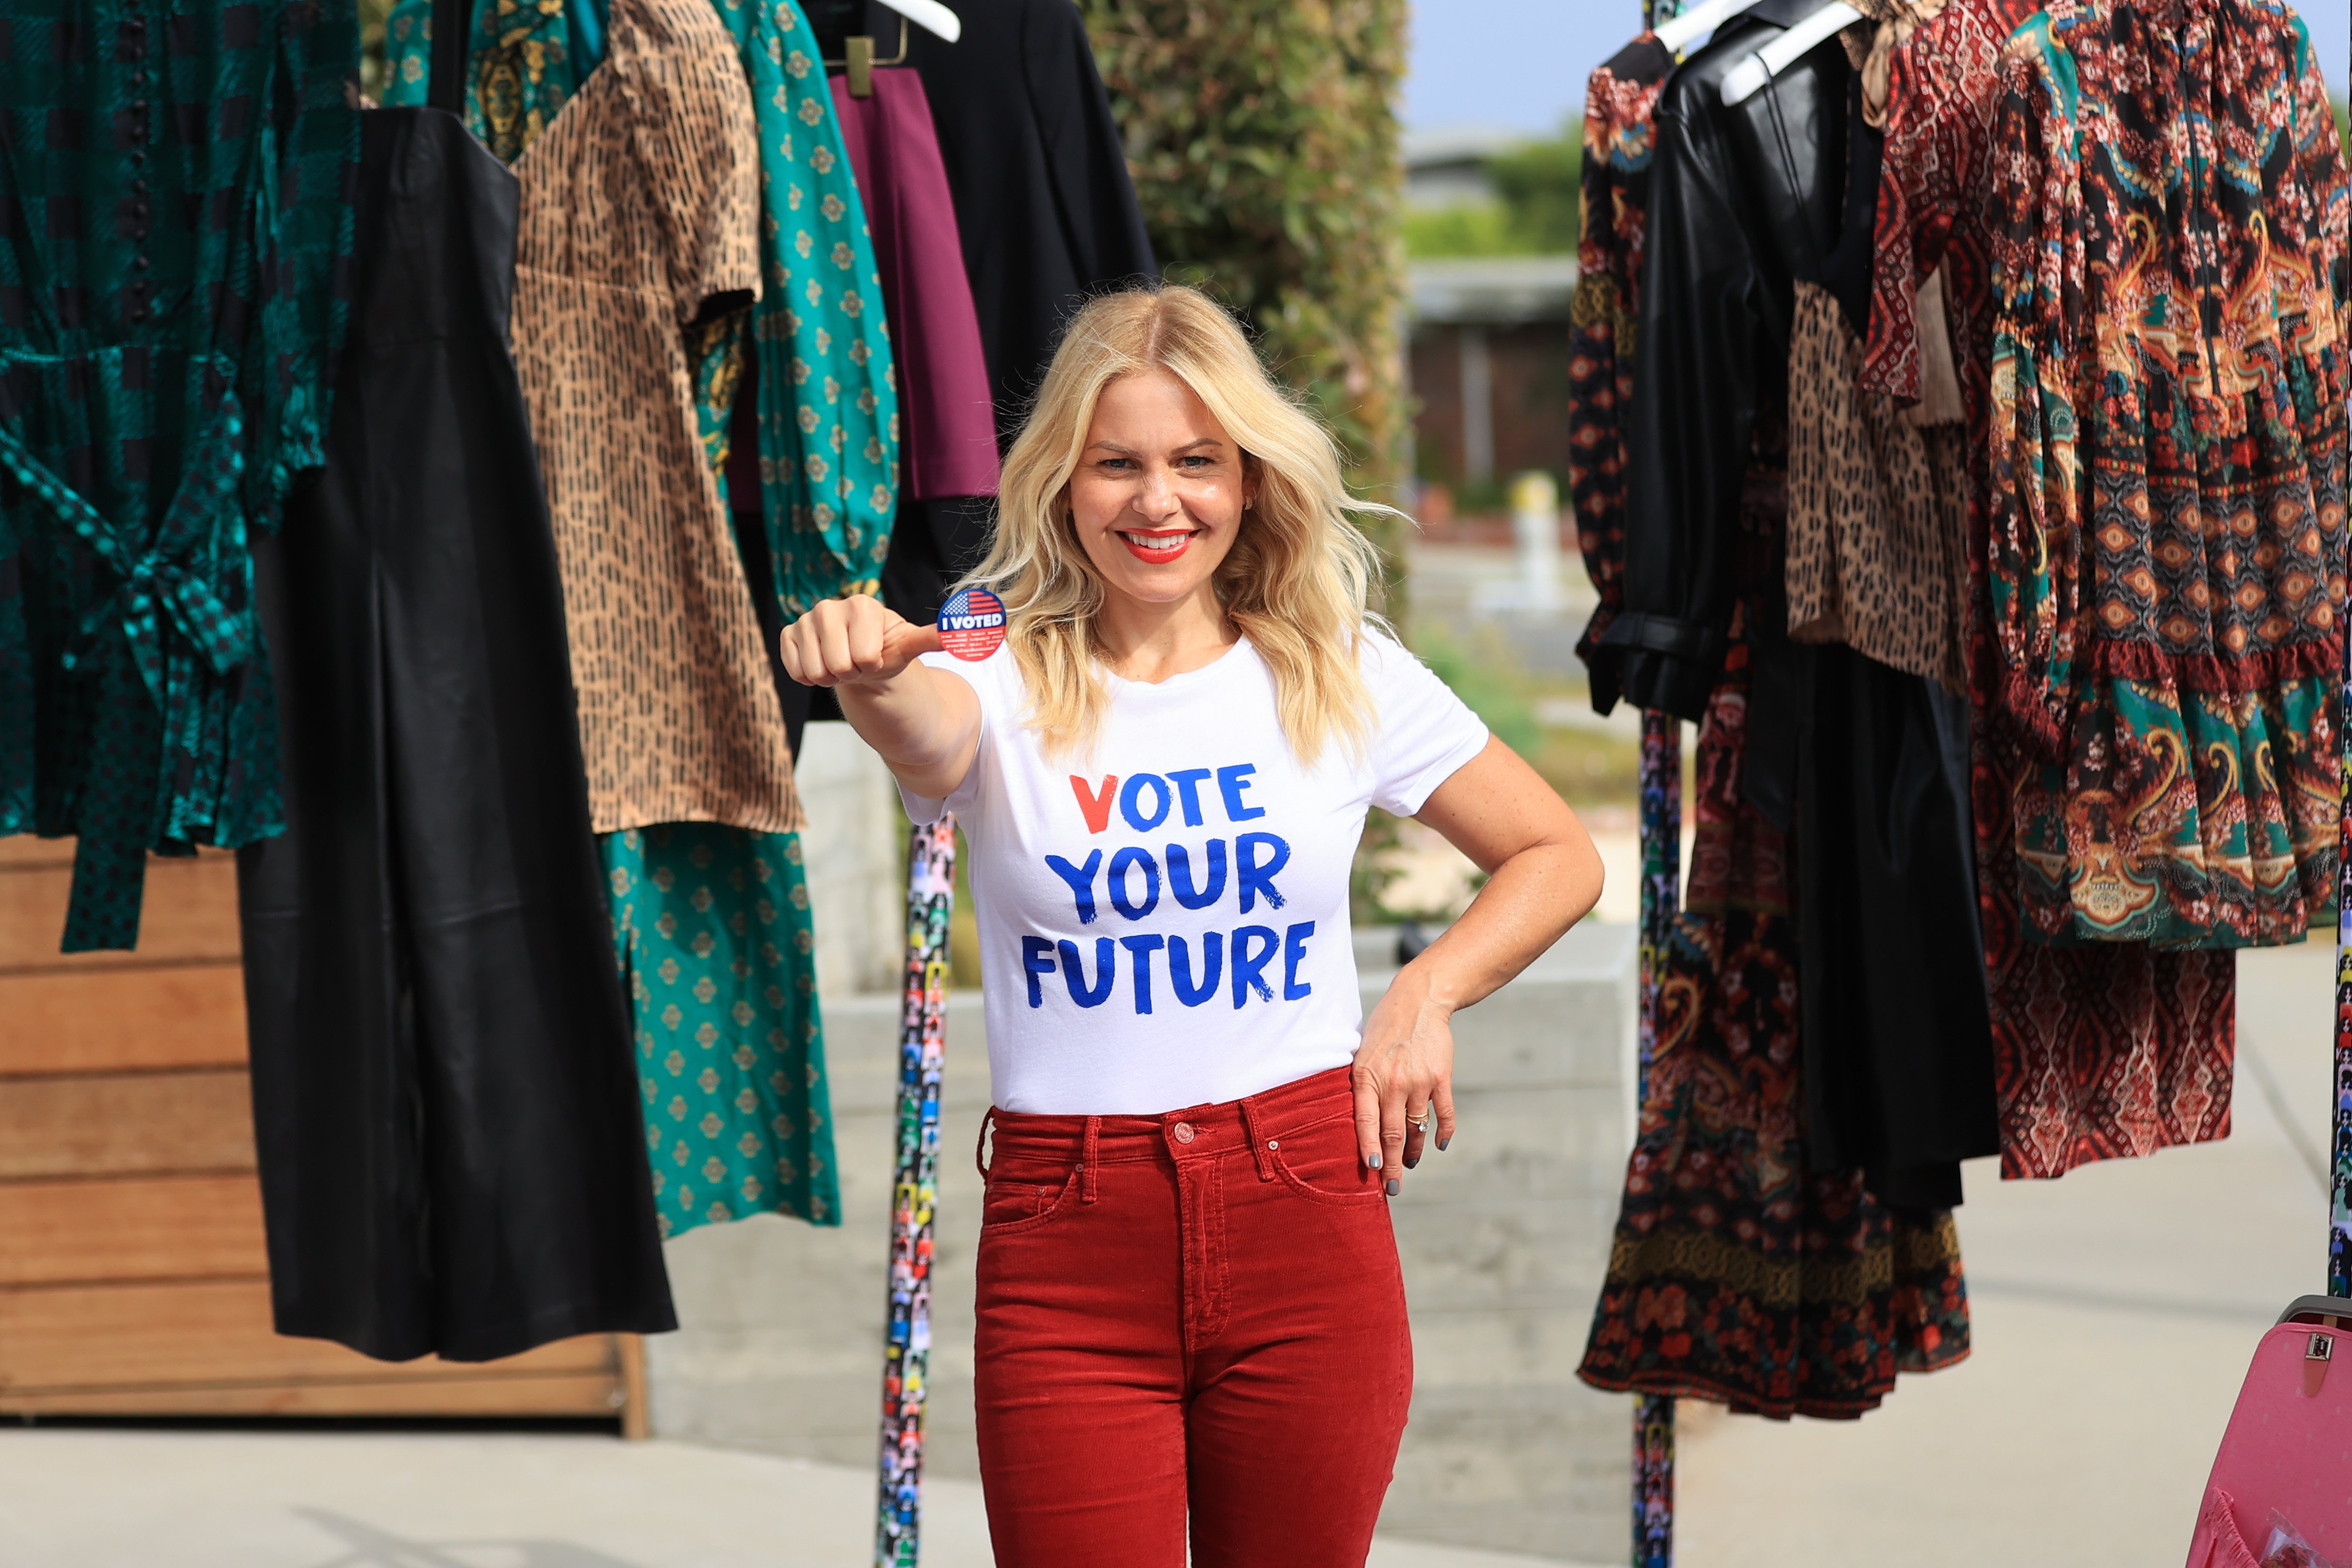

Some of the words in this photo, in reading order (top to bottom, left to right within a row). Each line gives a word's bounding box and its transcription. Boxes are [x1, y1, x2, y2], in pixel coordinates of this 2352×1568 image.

[942, 617, 948, 630] I
[950, 613, 1003, 630] VOTED
[1070, 763, 1265, 834] VOTE
[1045, 832, 1291, 924] YOUR
[1022, 921, 1315, 1014] FUTURE
